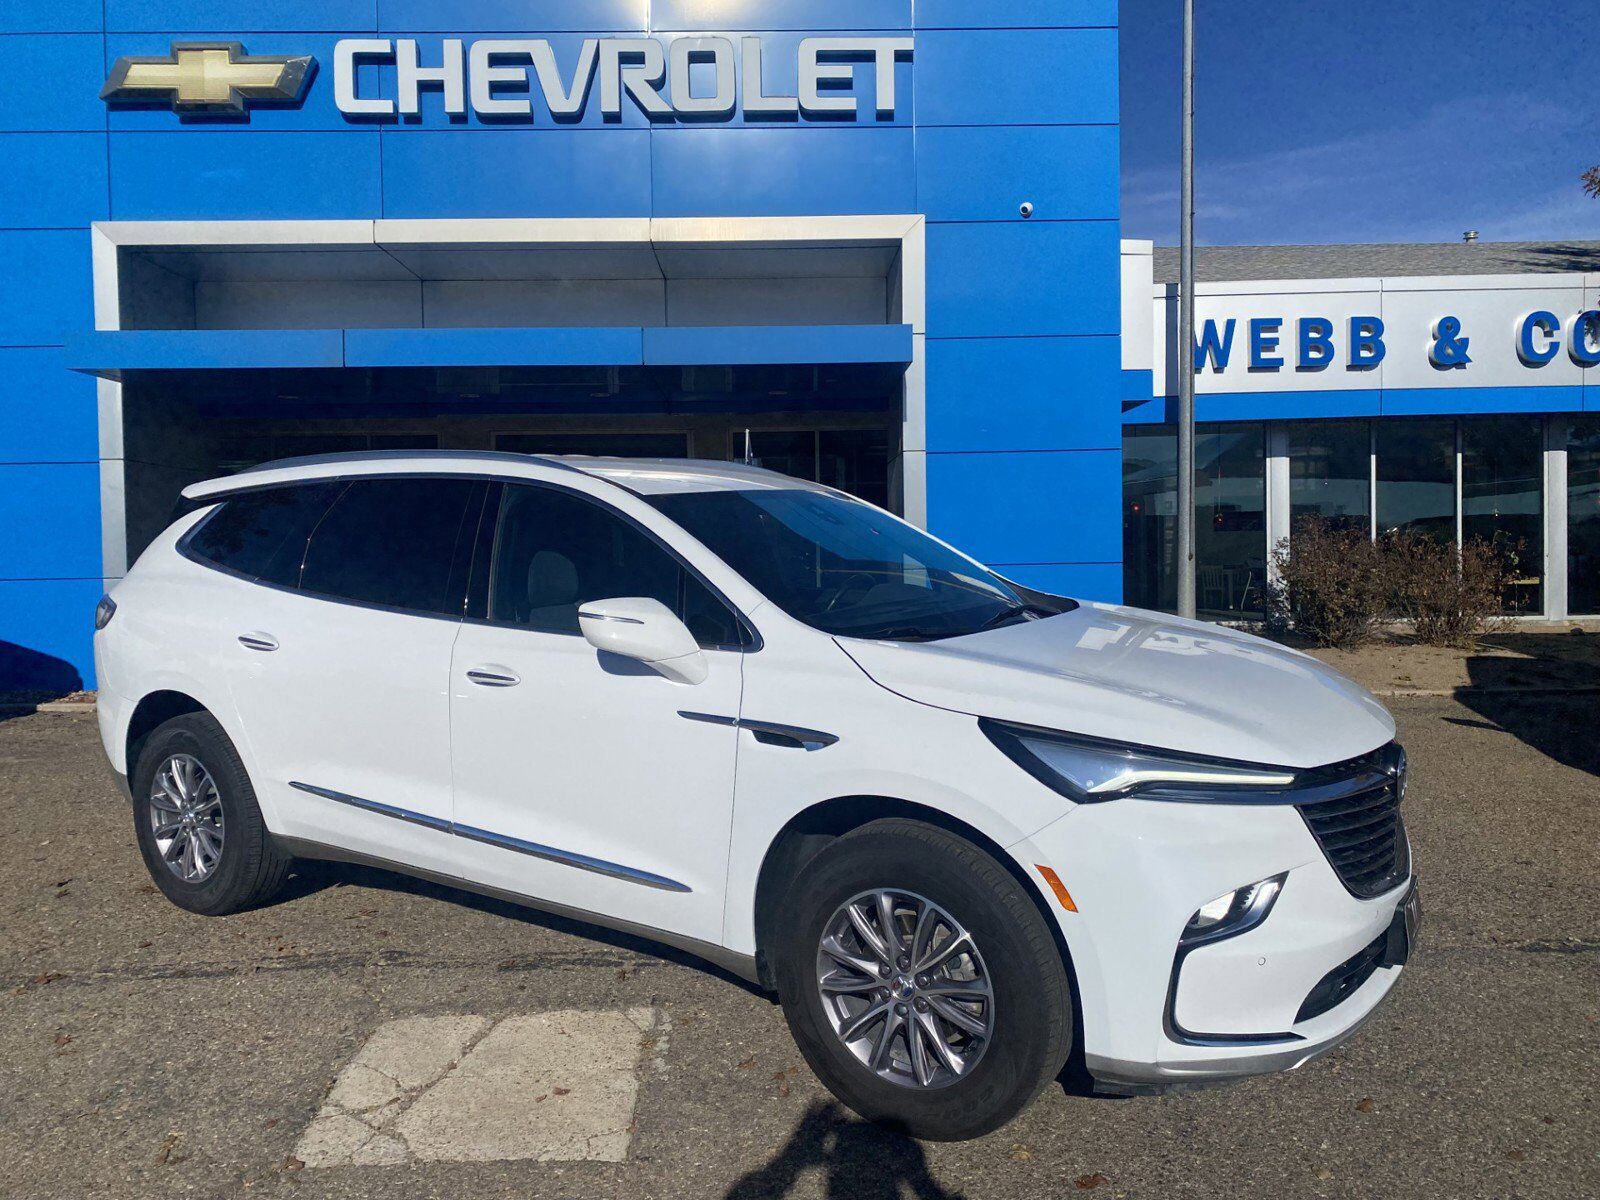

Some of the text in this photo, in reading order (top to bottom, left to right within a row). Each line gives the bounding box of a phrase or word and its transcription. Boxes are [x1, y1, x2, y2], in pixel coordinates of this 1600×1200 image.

[334, 37, 915, 119] CHEVROLET
[1195, 316, 1387, 372] WEBB
[1429, 316, 1471, 369] &
